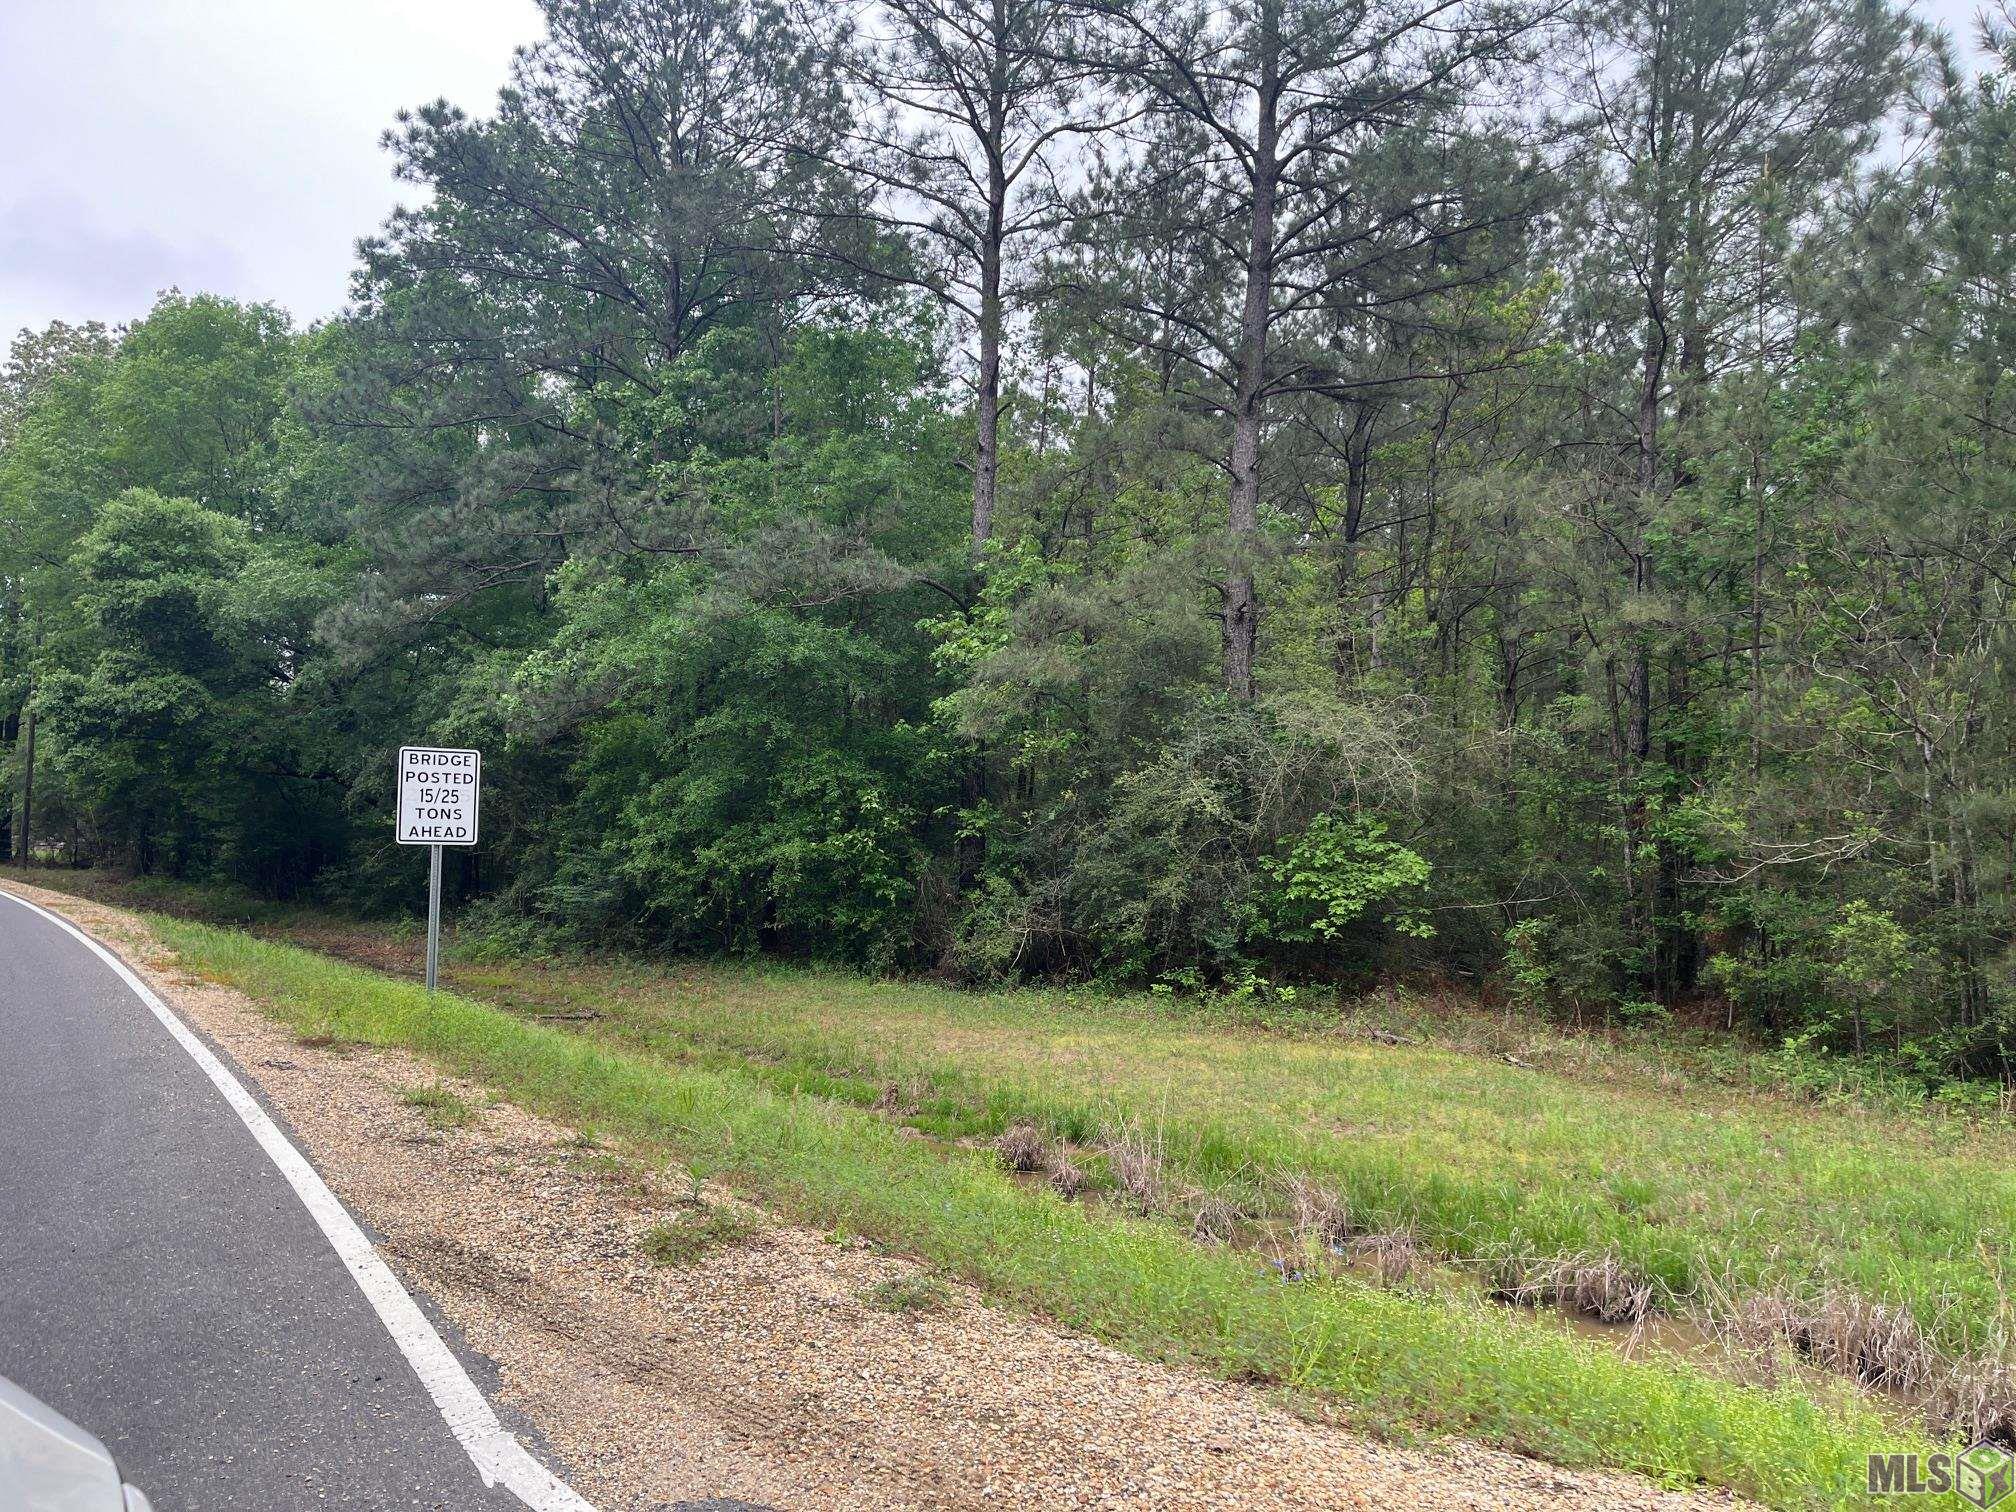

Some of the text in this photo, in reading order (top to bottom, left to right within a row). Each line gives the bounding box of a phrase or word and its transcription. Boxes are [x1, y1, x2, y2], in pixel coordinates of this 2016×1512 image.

[409, 753, 472, 767] BRIDGE
[405, 771, 474, 785] POSTED
[419, 787, 459, 804] 15/25
[415, 807, 462, 820] TONS
[408, 826, 467, 838] AHEAD
